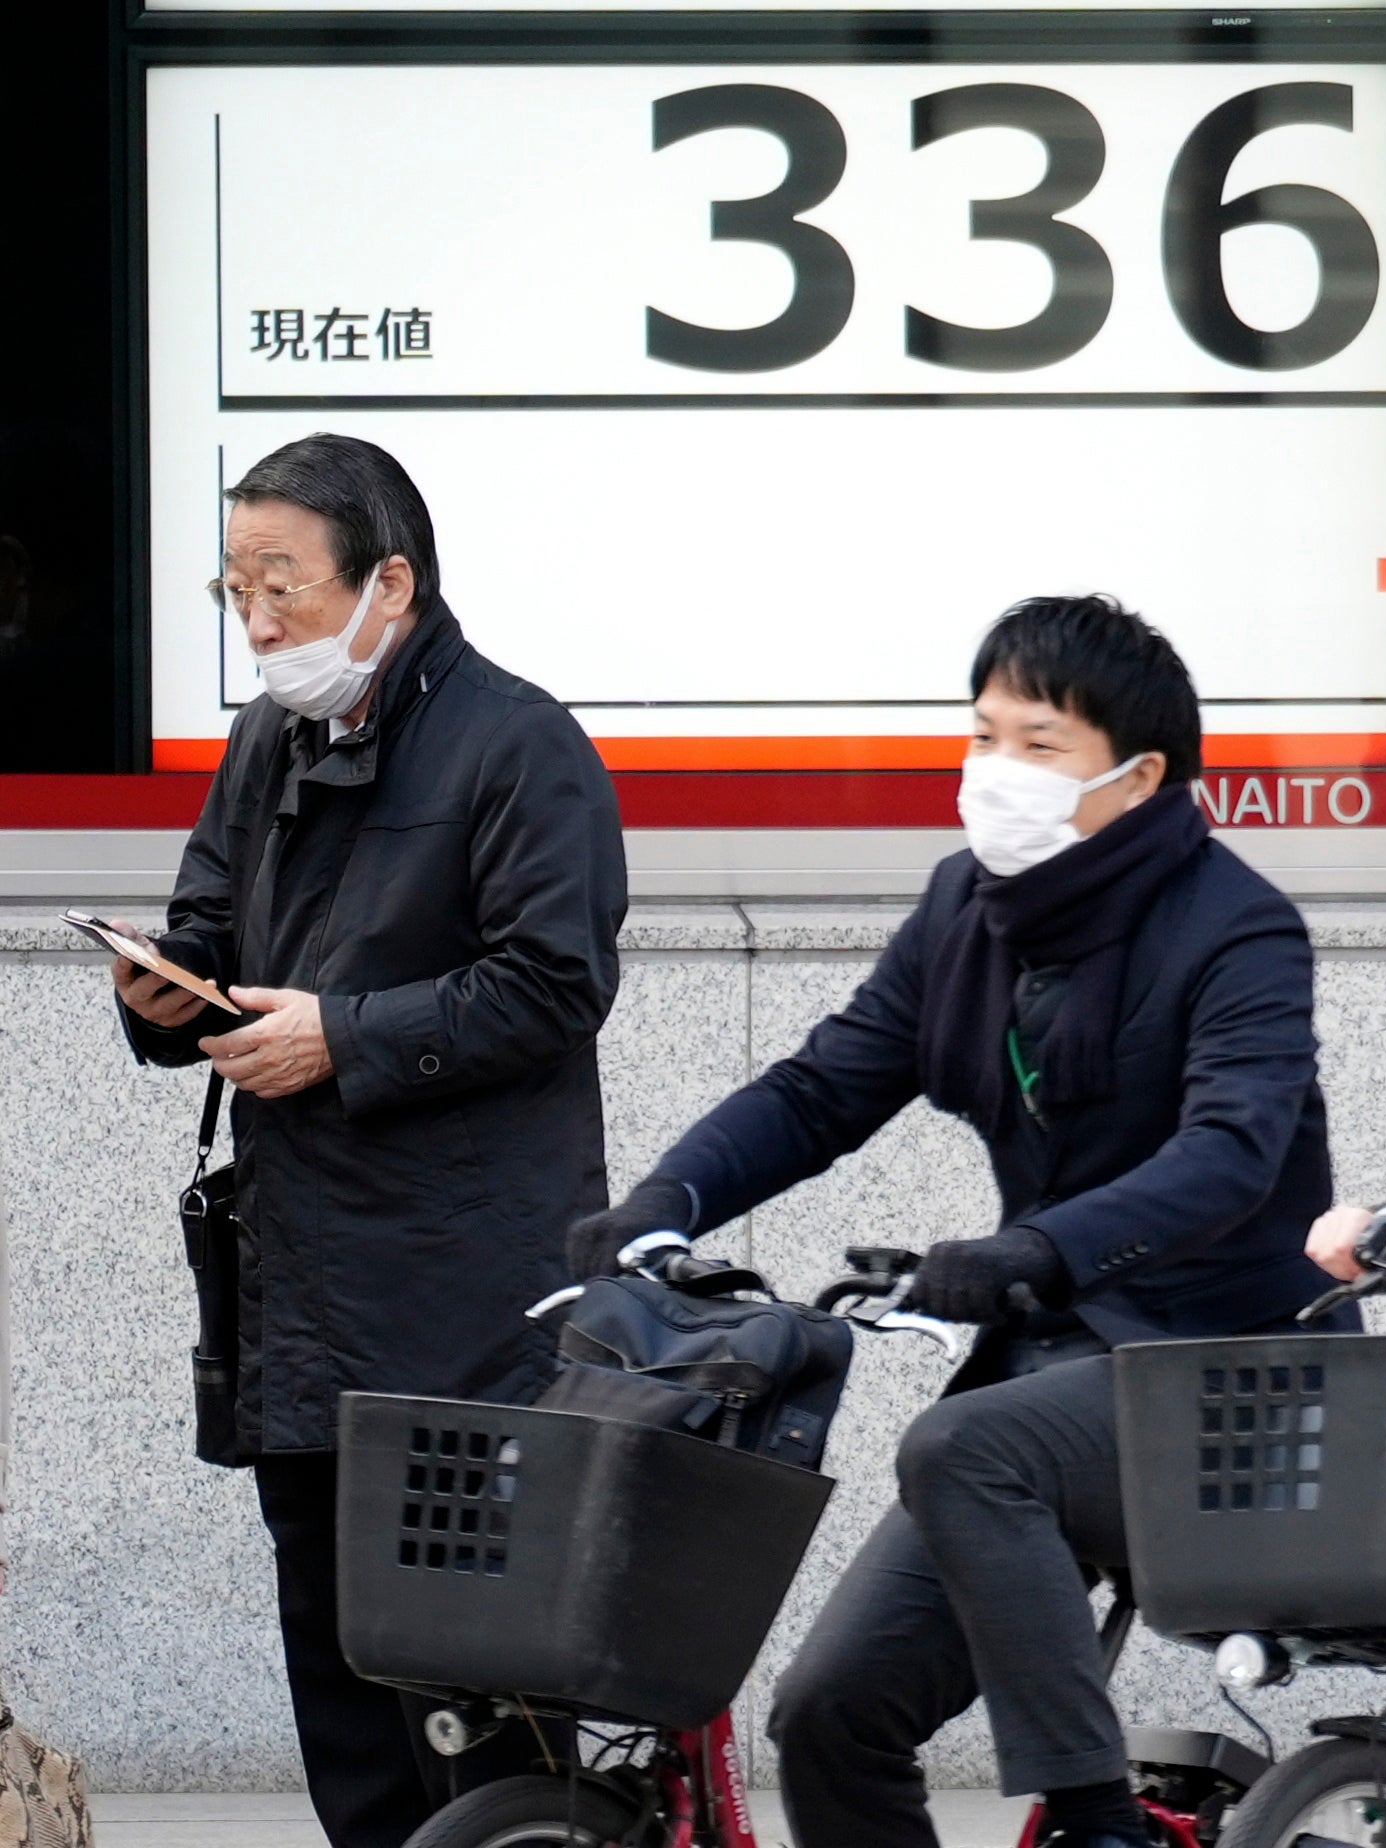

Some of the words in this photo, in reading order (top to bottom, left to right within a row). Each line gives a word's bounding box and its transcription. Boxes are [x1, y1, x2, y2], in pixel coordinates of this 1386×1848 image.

[1212, 17, 1251, 26] SHARP
[250, 307, 433, 361] 現在値
[1192, 777, 1371, 824] NAITO
